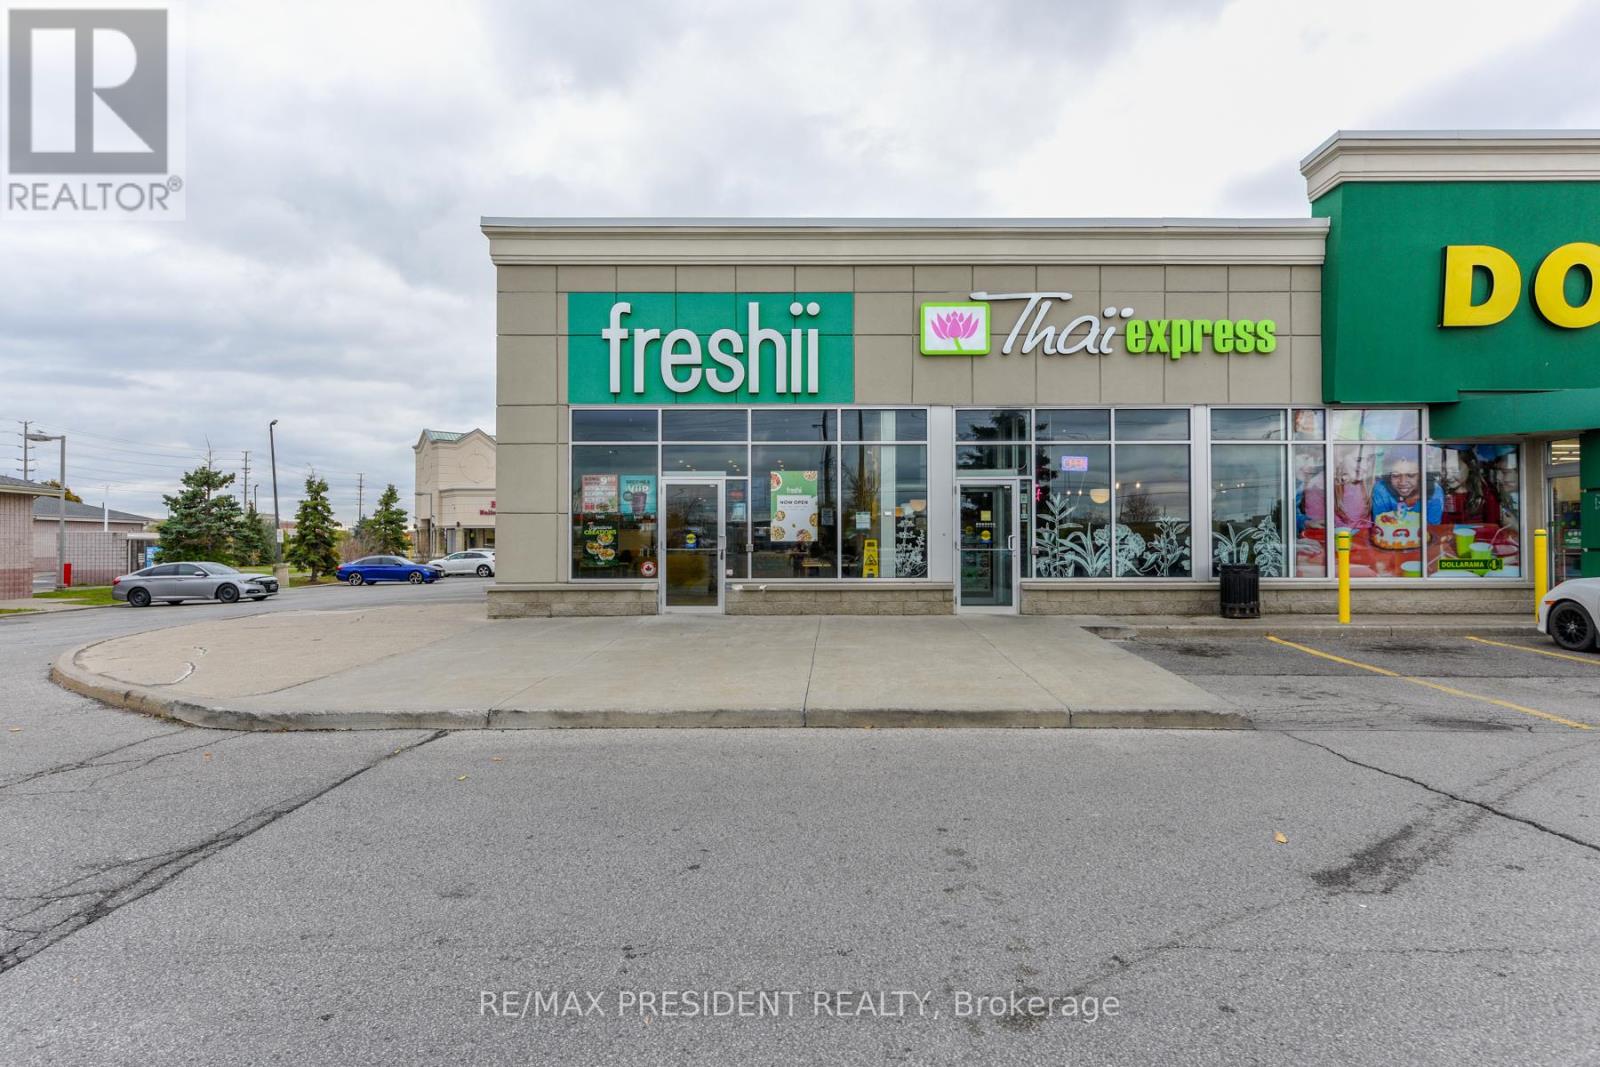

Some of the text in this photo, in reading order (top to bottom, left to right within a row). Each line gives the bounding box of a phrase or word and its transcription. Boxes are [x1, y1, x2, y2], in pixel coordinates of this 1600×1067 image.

[1438, 242, 1600, 329] DO
[602, 302, 820, 394] freshii
[1126, 319, 1275, 359] express
